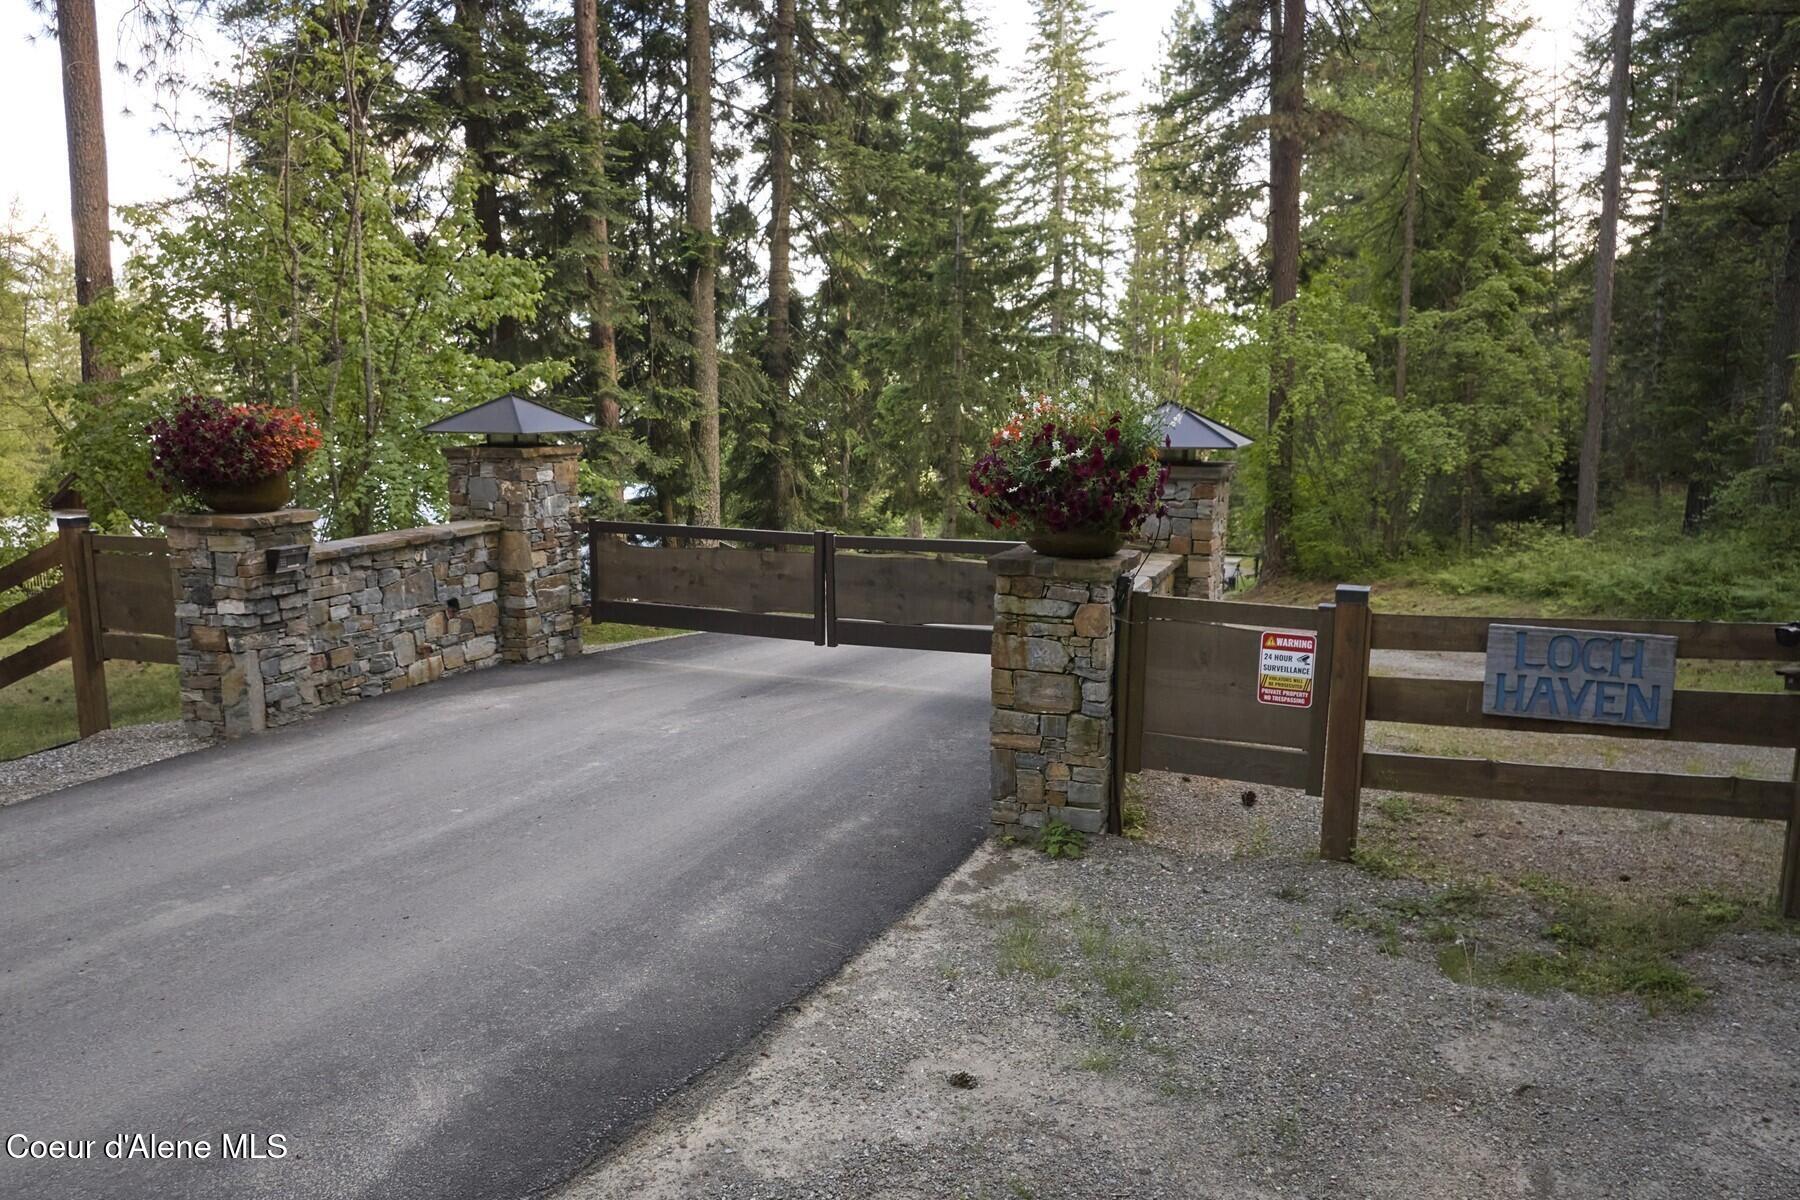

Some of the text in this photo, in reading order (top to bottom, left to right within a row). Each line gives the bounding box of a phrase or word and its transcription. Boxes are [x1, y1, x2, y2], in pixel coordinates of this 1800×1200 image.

[1276, 637, 1313, 649] WARNING
[1264, 653, 1272, 661] 24
[1514, 631, 1645, 679] LOCH
[1263, 663, 1310, 675] SURVEILLANCE
[1272, 696, 1305, 704] TRESPASSING
[1282, 690, 1309, 698] PROPERTY
[1492, 672, 1661, 722] HAVEN
